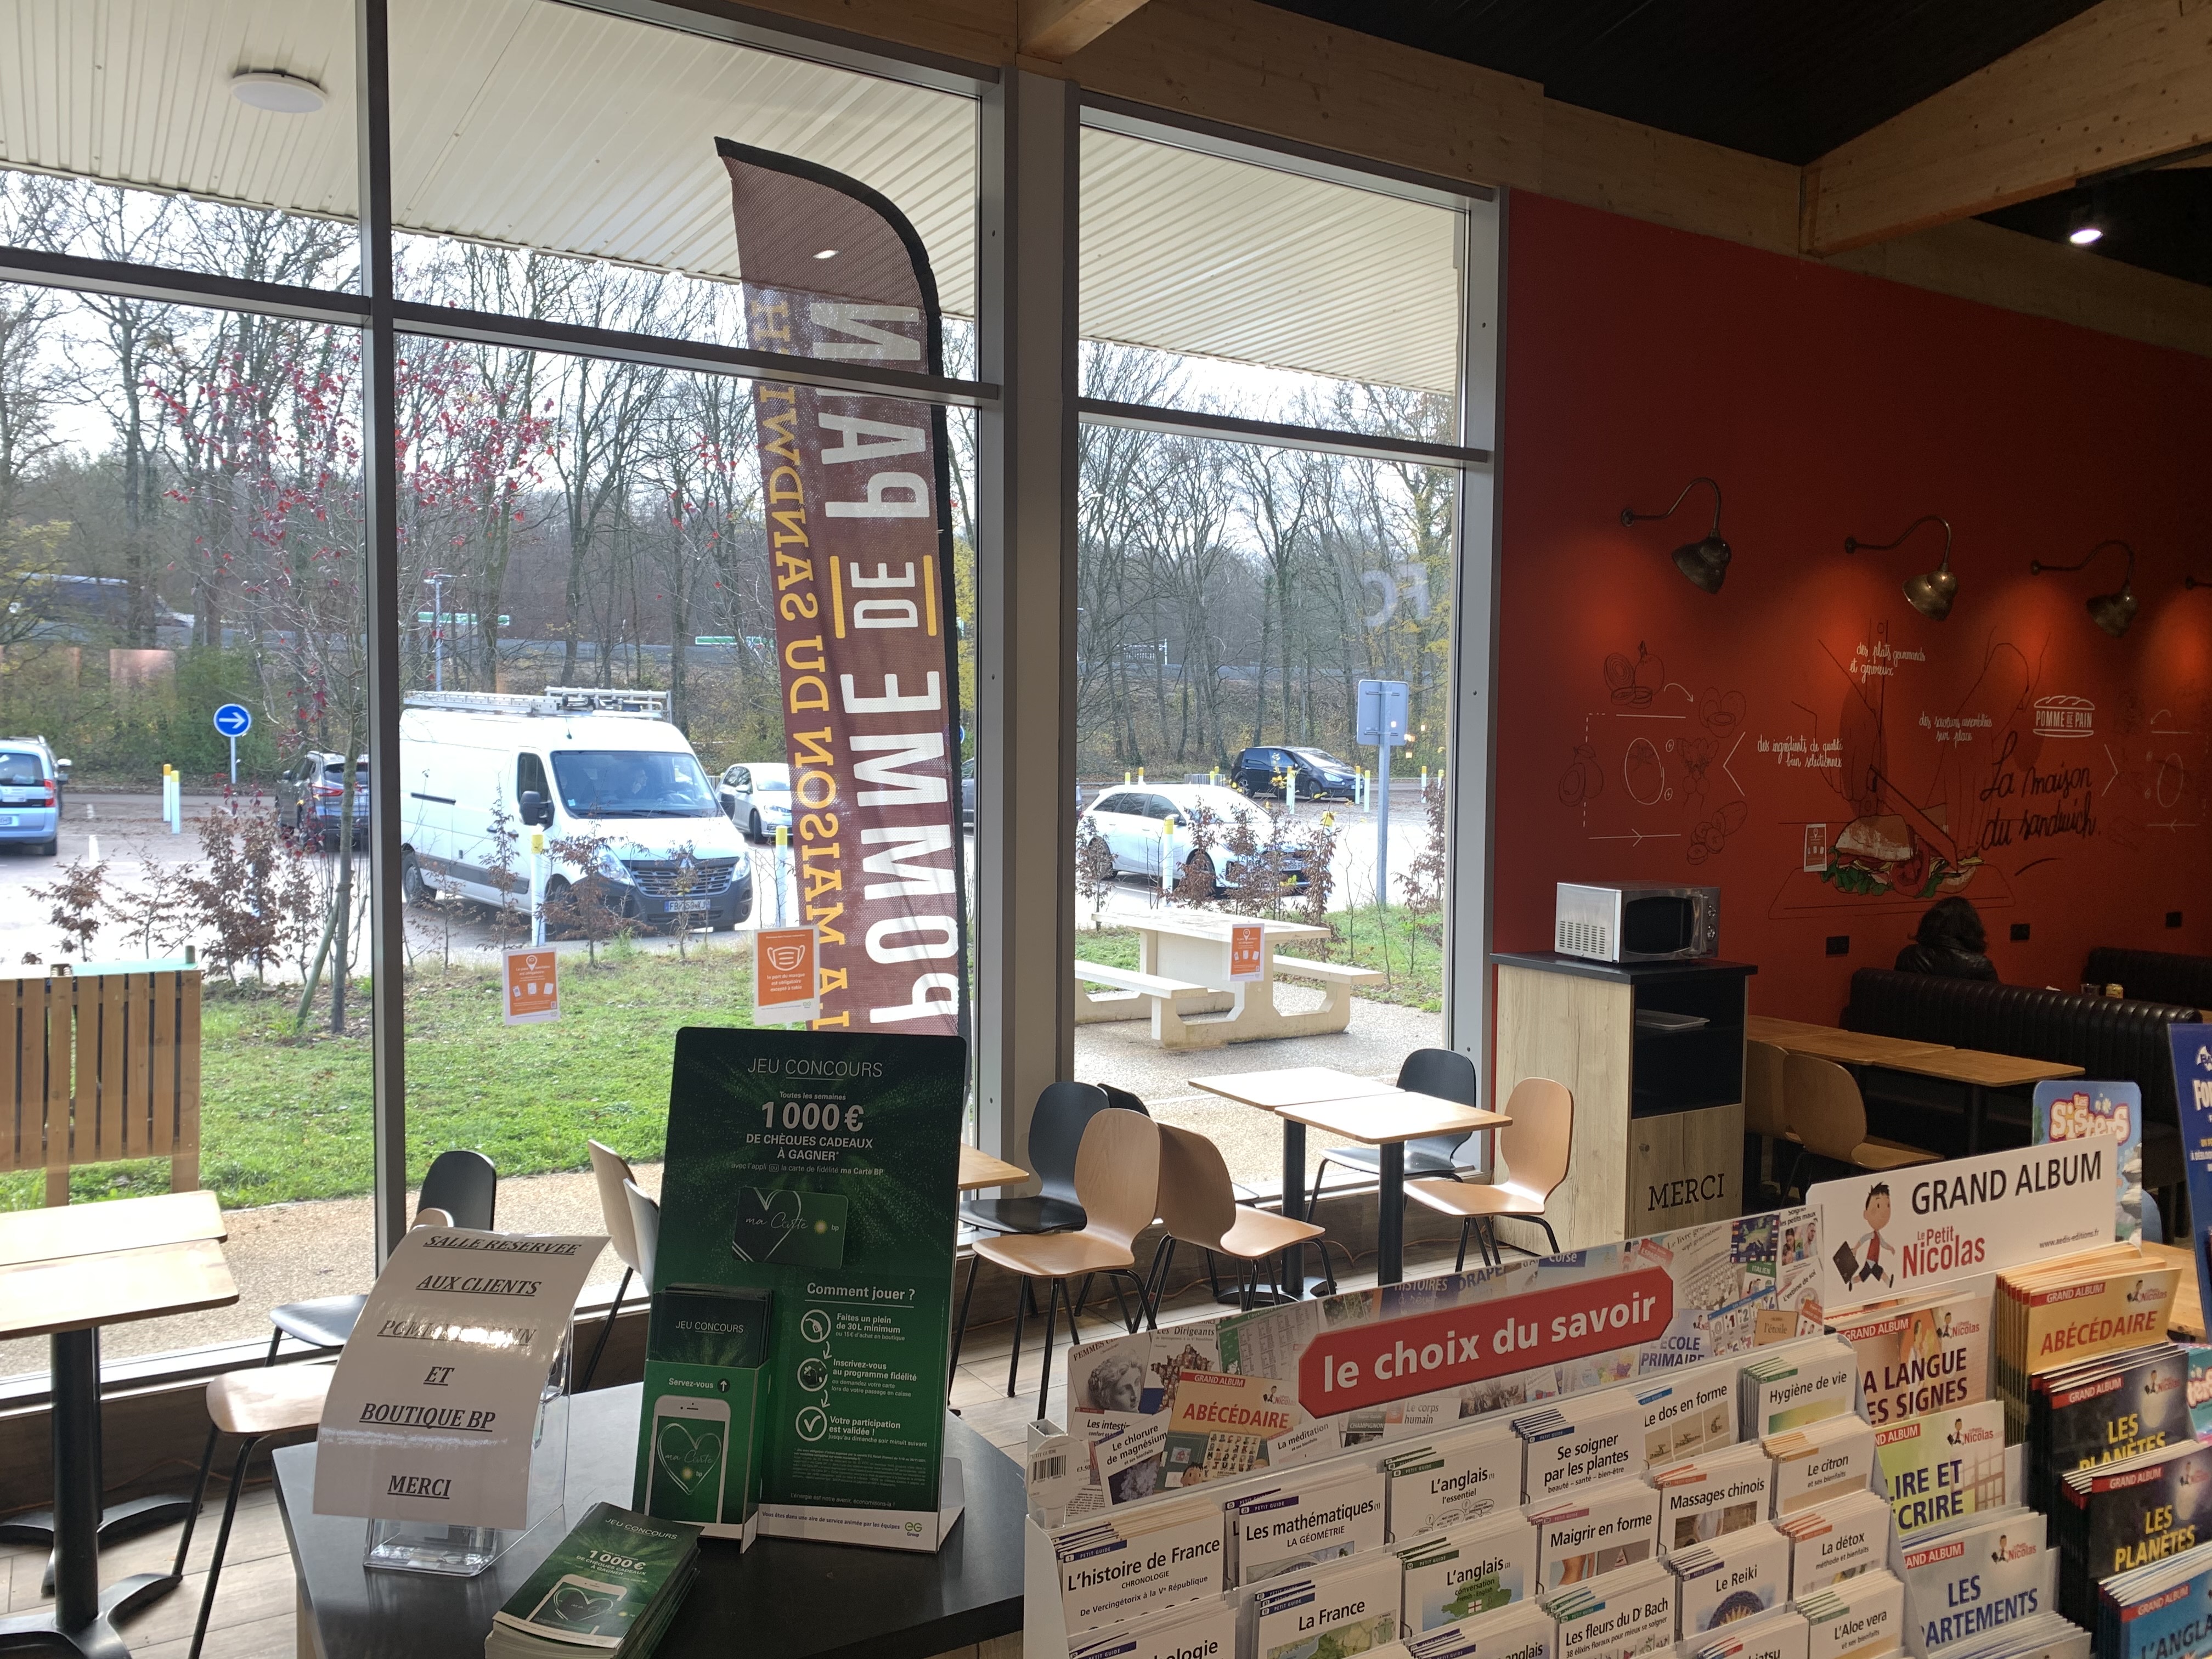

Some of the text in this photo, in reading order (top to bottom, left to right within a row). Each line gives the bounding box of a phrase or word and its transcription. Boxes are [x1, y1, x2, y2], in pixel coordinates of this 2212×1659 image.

[2036, 710, 2065, 727] POMME
[2075, 712, 2092, 728] PAIN
[1810, 737, 1820, 752] de
[1980, 730, 2092, 801] La maison
[1982, 808, 2012, 850] du
[747, 1058, 883, 1077] JEU CONCOURS
[746, 1132, 873, 1149] DE CHÈQUES CADEAUX
[1647, 1173, 1726, 1211] MERCI
[1911, 1150, 2102, 1215] GRAND ALBUM
[424, 1235, 583, 1255] SALLE RESERVEE
[2039, 1228, 2100, 1249] www.aedis-editions.fr
[1902, 1234, 1986, 1279] Nicolas
[417, 1274, 542, 1295] AUX CLIENTS
[806, 1282, 916, 1301] Comment jouer ?
[2046, 1284, 2104, 1304] GRAND ALBUM
[675, 1321, 744, 1334] JEU CONCOURS
[1324, 1290, 1656, 1393] le choix du savoir
[1844, 1318, 1909, 1342] GRAND ALBUM
[1952, 1323, 1980, 1338] Nicolas
[2040, 1310, 2158, 1356] ABÉCÉDAIRE
[424, 1366, 455, 1383] ET
[833, 1358, 887, 1370] Inscrivez-vous
[1863, 1347, 1967, 1396] A LANGUE
[668, 1377, 714, 1390] Servez-vous
[1194, 1374, 1244, 1387] GRAND ALBUM
[1769, 1371, 1848, 1404] Hygiène de vie
[2069, 1377, 2123, 1403] GRAND ALBUM
[1866, 1376, 1968, 1425] ES SIGNES
[360, 1403, 496, 1429] BOUTIQUE BP
[830, 1415, 901, 1429] Votre participation
[1182, 1401, 1290, 1429] ABÉCÉDAIRE
[1404, 1414, 1434, 1425] humain
[2108, 1413, 2140, 1444] LES
[1113, 1424, 1159, 1452] Le chlorure
[1277, 1423, 1329, 1451] La méditation
[1557, 1433, 1619, 1461] Se soigner
[1888, 1425, 1918, 1443] ALBUM
[1963, 1429, 1994, 1444] Nicolas
[1107, 1432, 1167, 1466] de magnésium
[1543, 1448, 1629, 1487] par les plantes
[1807, 1454, 1849, 1477] Le citron
[1937, 1458, 1963, 1489] ET
[2109, 1467, 2162, 1489] GRAND ALBUM
[388, 1475, 452, 1497] MERCI
[1442, 1487, 1477, 1505] l'essentiel
[1670, 1476, 1765, 1510] Massages chinois
[1893, 1489, 1964, 1531] CRIRE
[2145, 1504, 2173, 1535] LES
[844, 1519, 863, 1527] animée
[881, 1522, 900, 1531] équipes
[1550, 1513, 1652, 1548] Maigrir en forme
[1821, 1530, 1865, 1556] La détox
[2114, 1524, 2196, 1572] PLANÈTES
[1067, 1538, 1221, 1592] L'histoire de France
[1715, 1564, 1758, 1593] Le Reiki
[1121, 1570, 1170, 1590] CHRONOLOGIE
[1948, 1575, 1982, 1609] LES
[1080, 1607, 1091, 1617] De
[1092, 1593, 1142, 1615] Vercingétorix
[1142, 1590, 1148, 1599] à
[1149, 1588, 1158, 1598] la
[1168, 1575, 1209, 1593] République
[1298, 1600, 1365, 1632] La France
[1833, 1609, 1888, 1641] L'Aloe vera
[1921, 1587, 2039, 1648] ARTEMENTS
